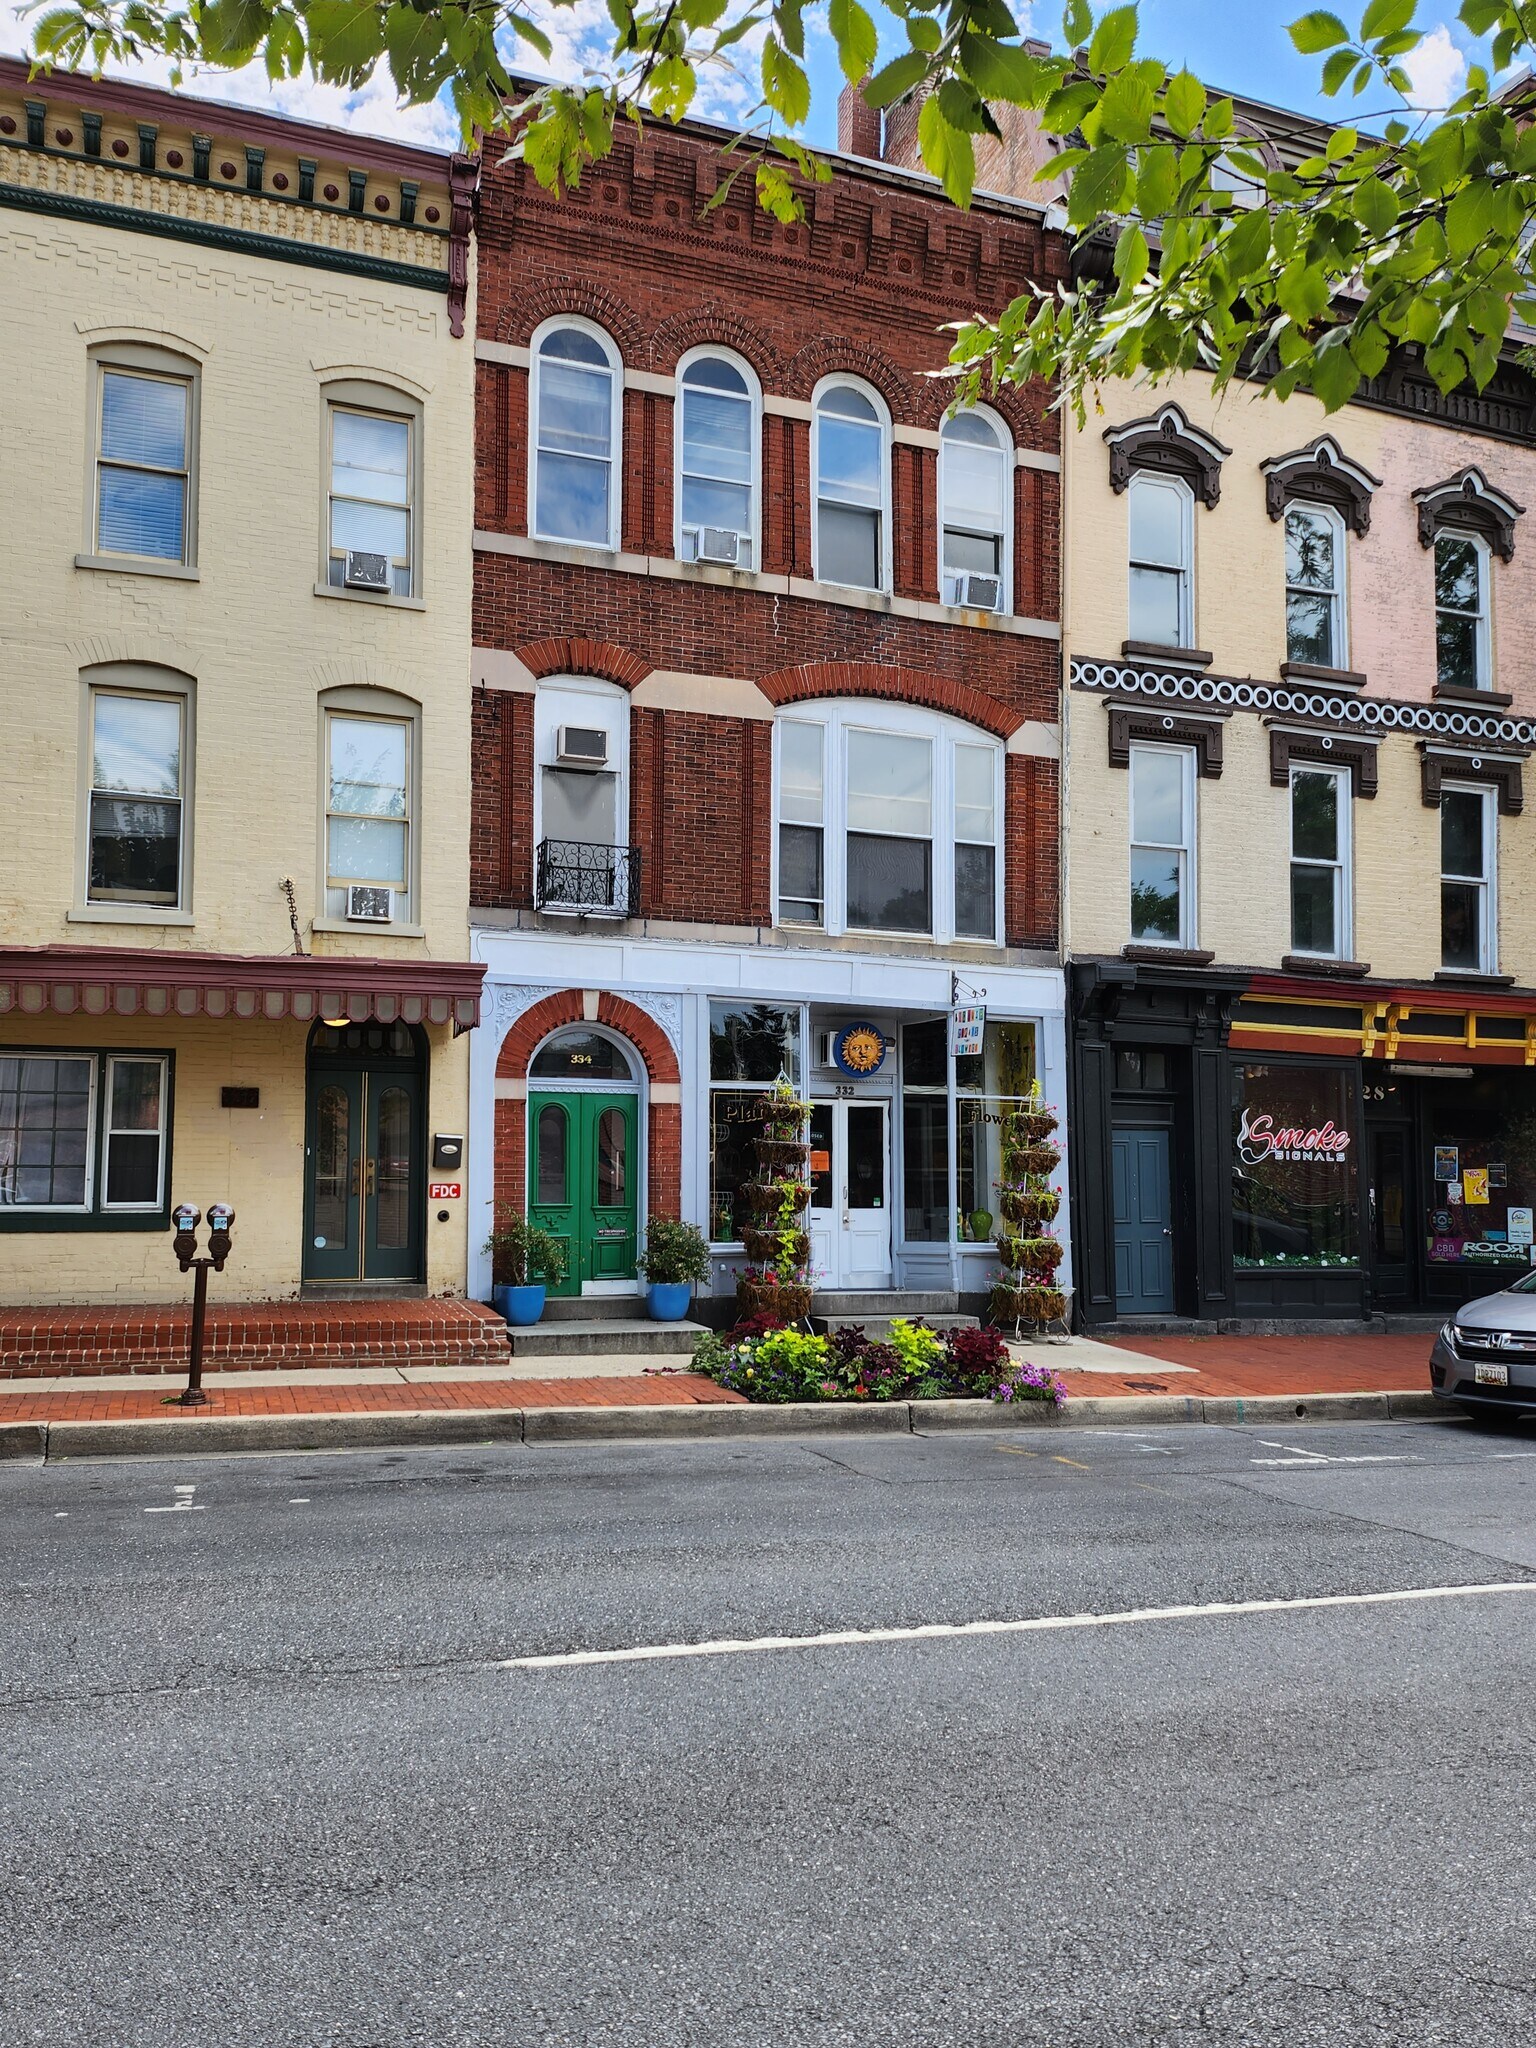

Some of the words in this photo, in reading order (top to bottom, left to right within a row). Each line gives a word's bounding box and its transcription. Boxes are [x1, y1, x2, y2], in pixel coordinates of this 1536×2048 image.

[570, 1054, 592, 1064] 334
[835, 1086, 855, 1096] 332
[968, 1109, 1013, 1127] Flowe
[1249, 1114, 1351, 1152] Smoke
[1274, 1150, 1346, 1162] SIGNALS
[432, 1184, 457, 1198] FDC
[1436, 1244, 1455, 1252] CBD
[1463, 1242, 1524, 1254] ROOR
